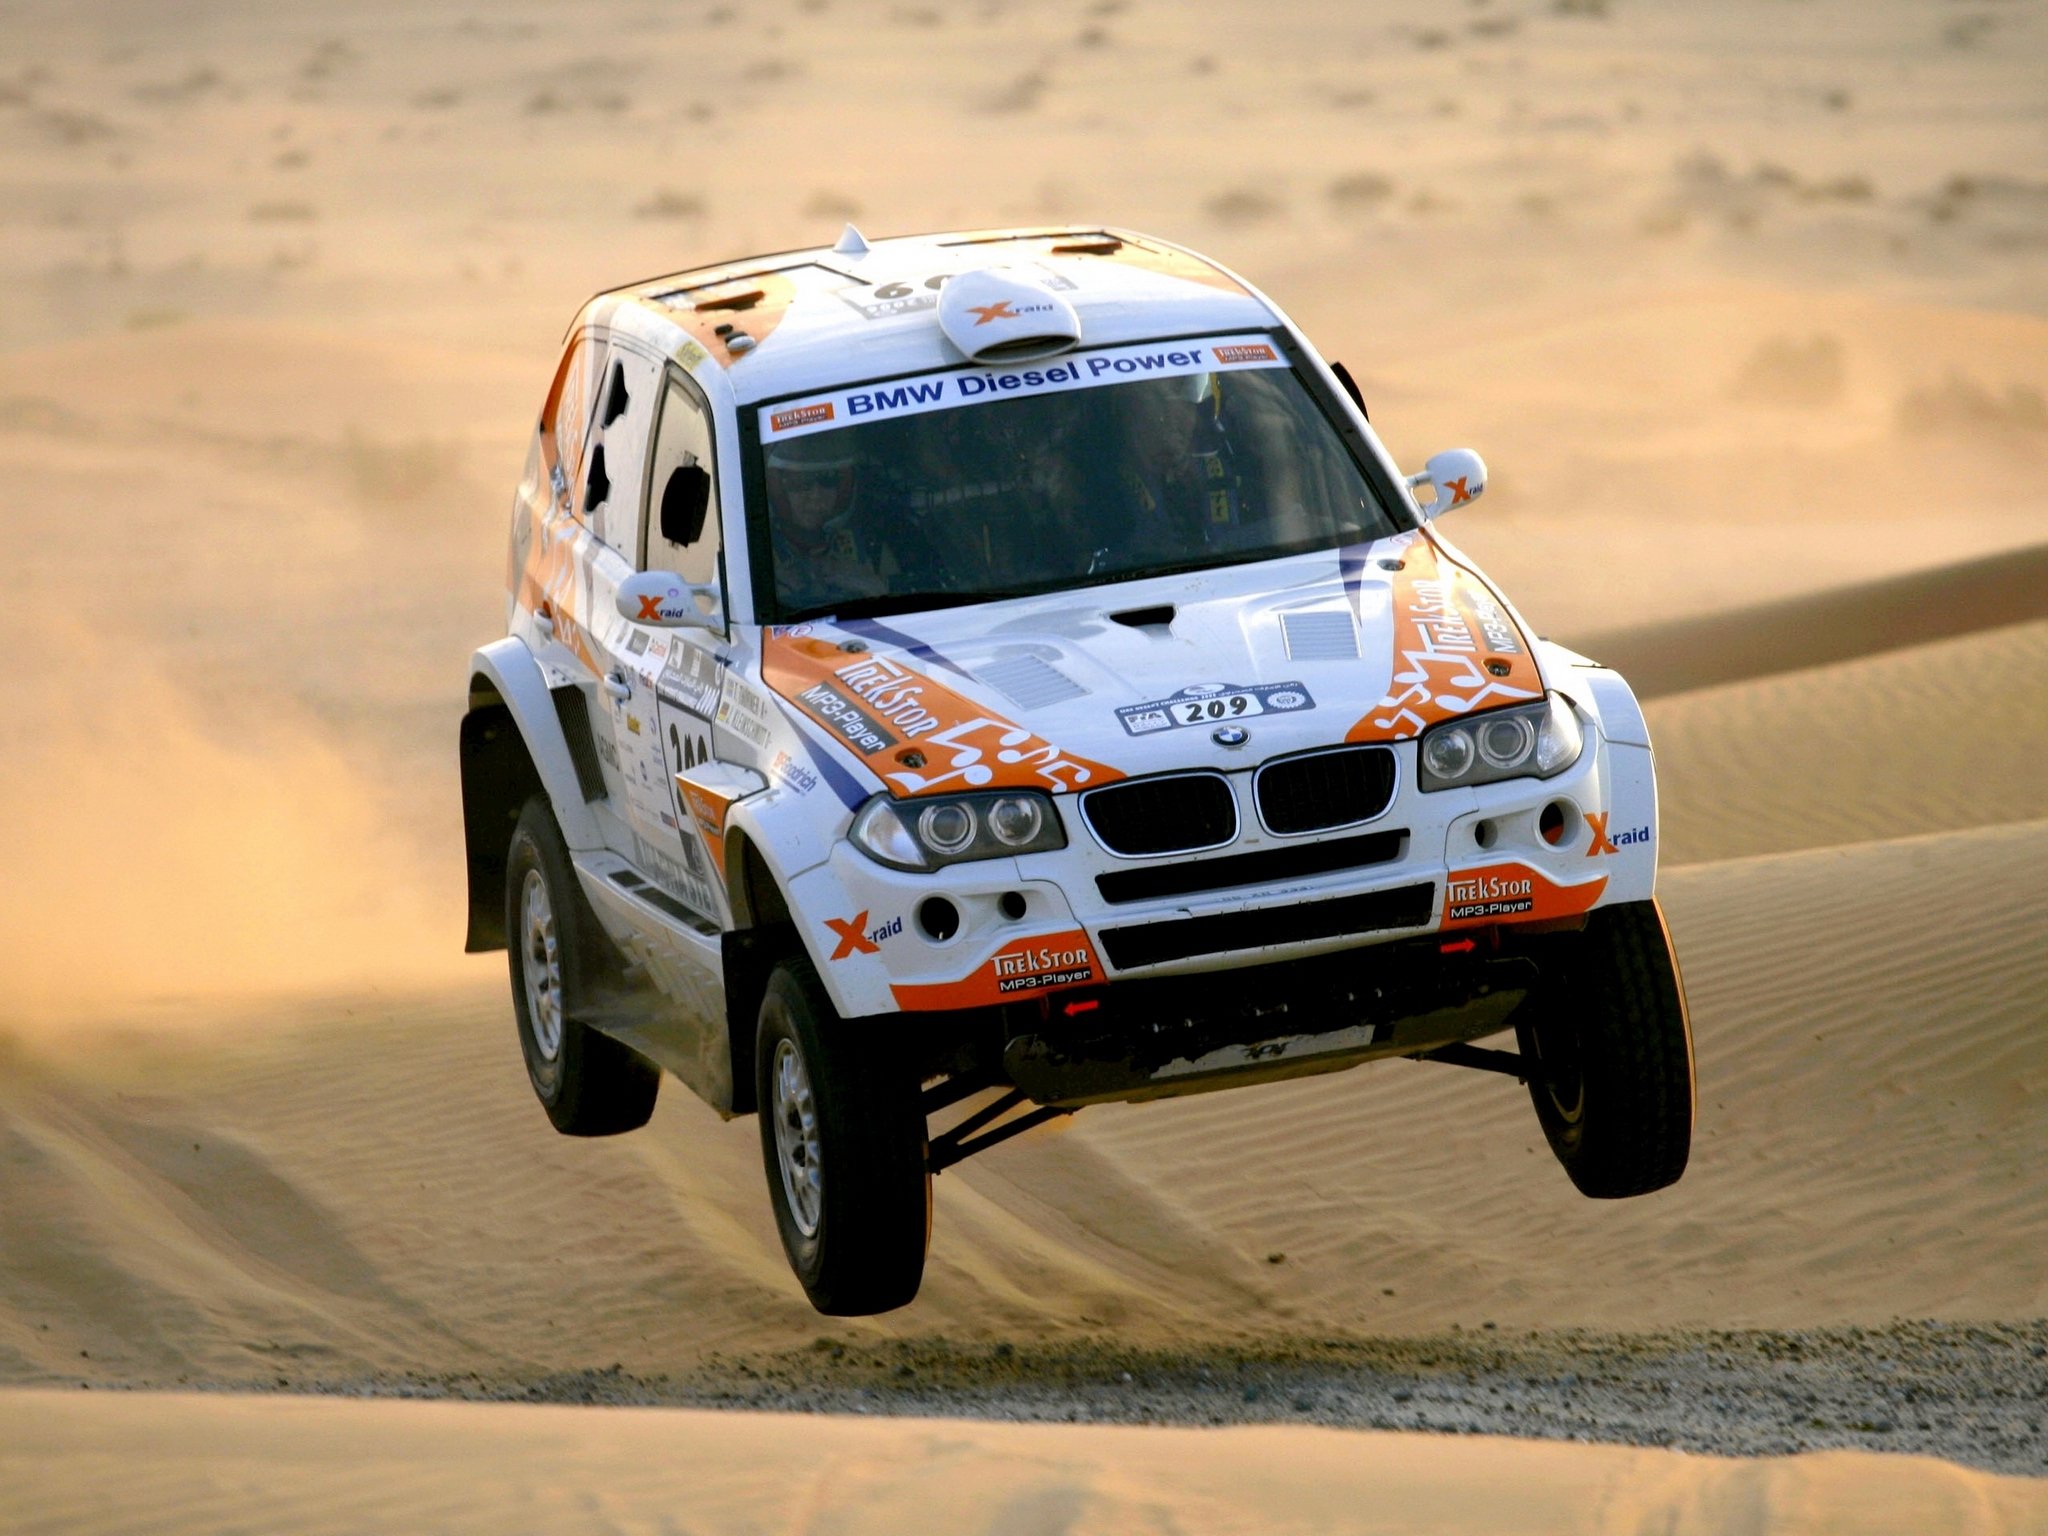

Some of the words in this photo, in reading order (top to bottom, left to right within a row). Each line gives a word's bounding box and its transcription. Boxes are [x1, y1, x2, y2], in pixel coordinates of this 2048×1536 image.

[848, 381, 944, 416] BMW
[957, 361, 1081, 397] Diesel
[1086, 348, 1202, 377] Power
[801, 684, 886, 753] MP3-Player
[1185, 696, 1248, 723] 209
[1584, 811, 1650, 857] X-raid
[1451, 900, 1532, 918] MP3-Player
[823, 910, 903, 961] X-raid
[1001, 969, 1091, 992] MP3-Player
